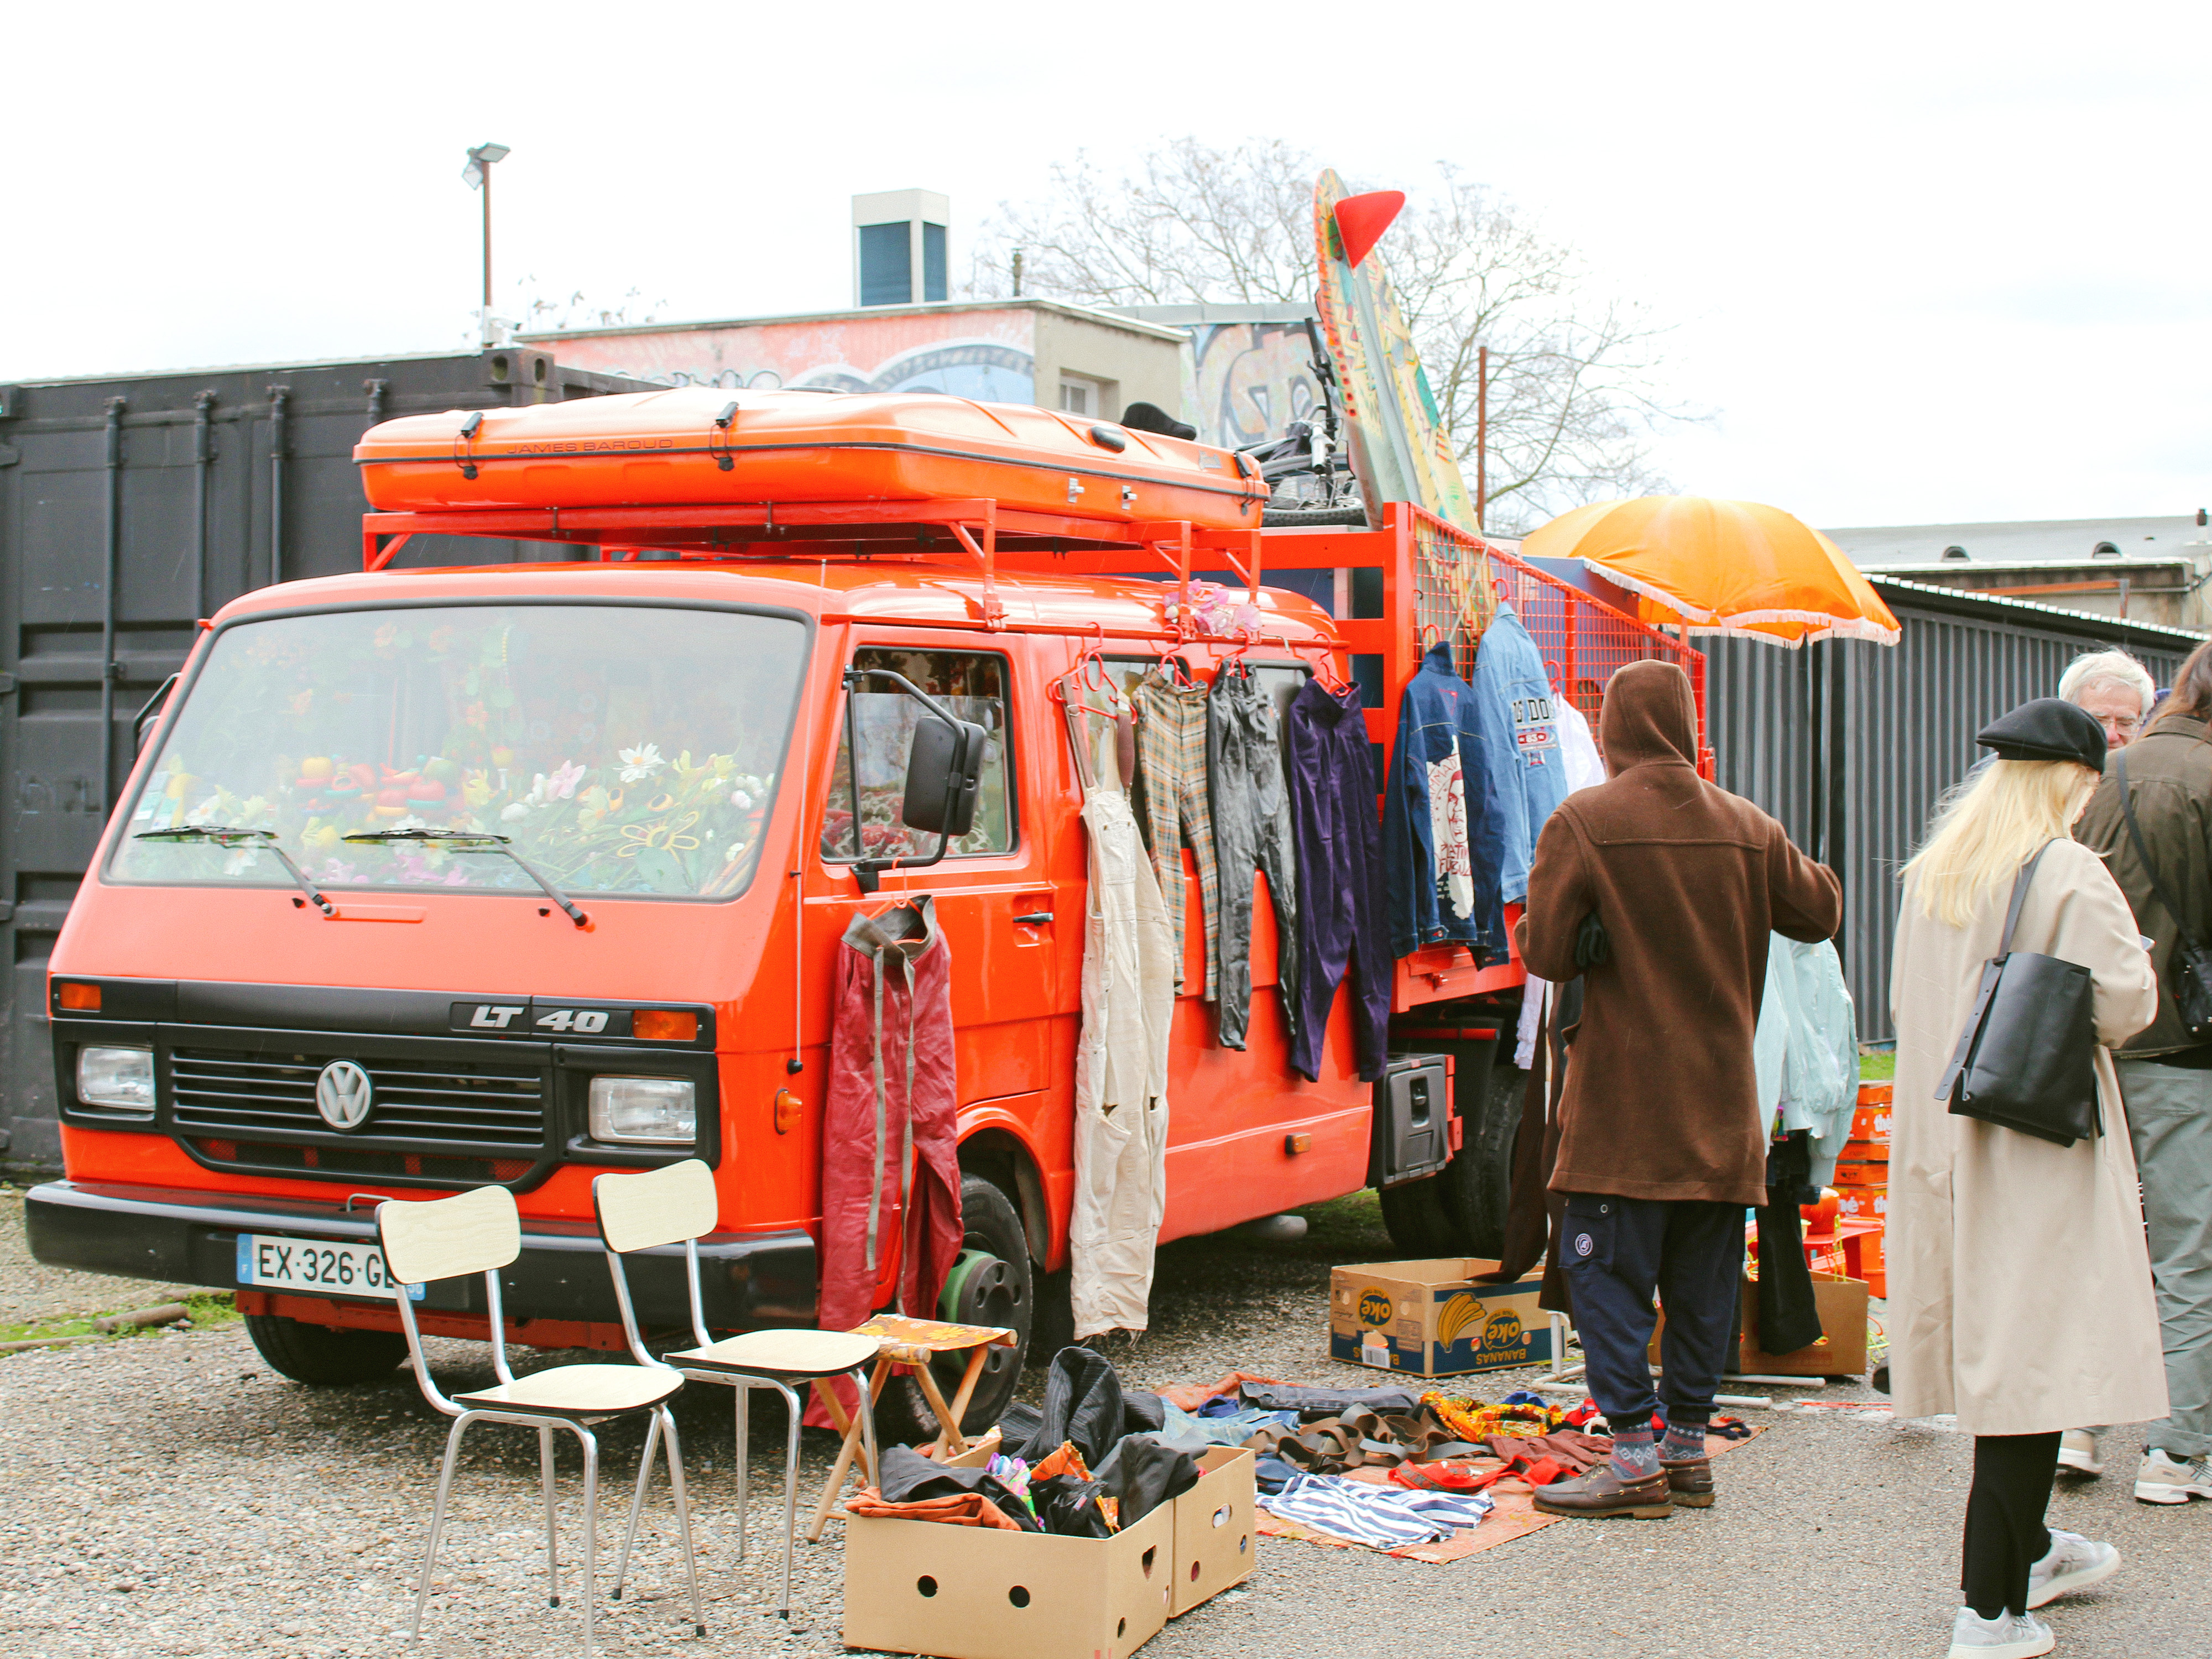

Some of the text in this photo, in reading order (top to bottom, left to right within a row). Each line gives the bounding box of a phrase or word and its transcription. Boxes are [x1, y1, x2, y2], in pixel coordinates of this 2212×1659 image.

[507, 440, 673, 453] JAMES BAROUD
[470, 1006, 609, 1033] LT 40
[1361, 1300, 1391, 1322] oké
[1487, 1322, 1520, 1345] oké
[1476, 1348, 1526, 1365] BANANAS
